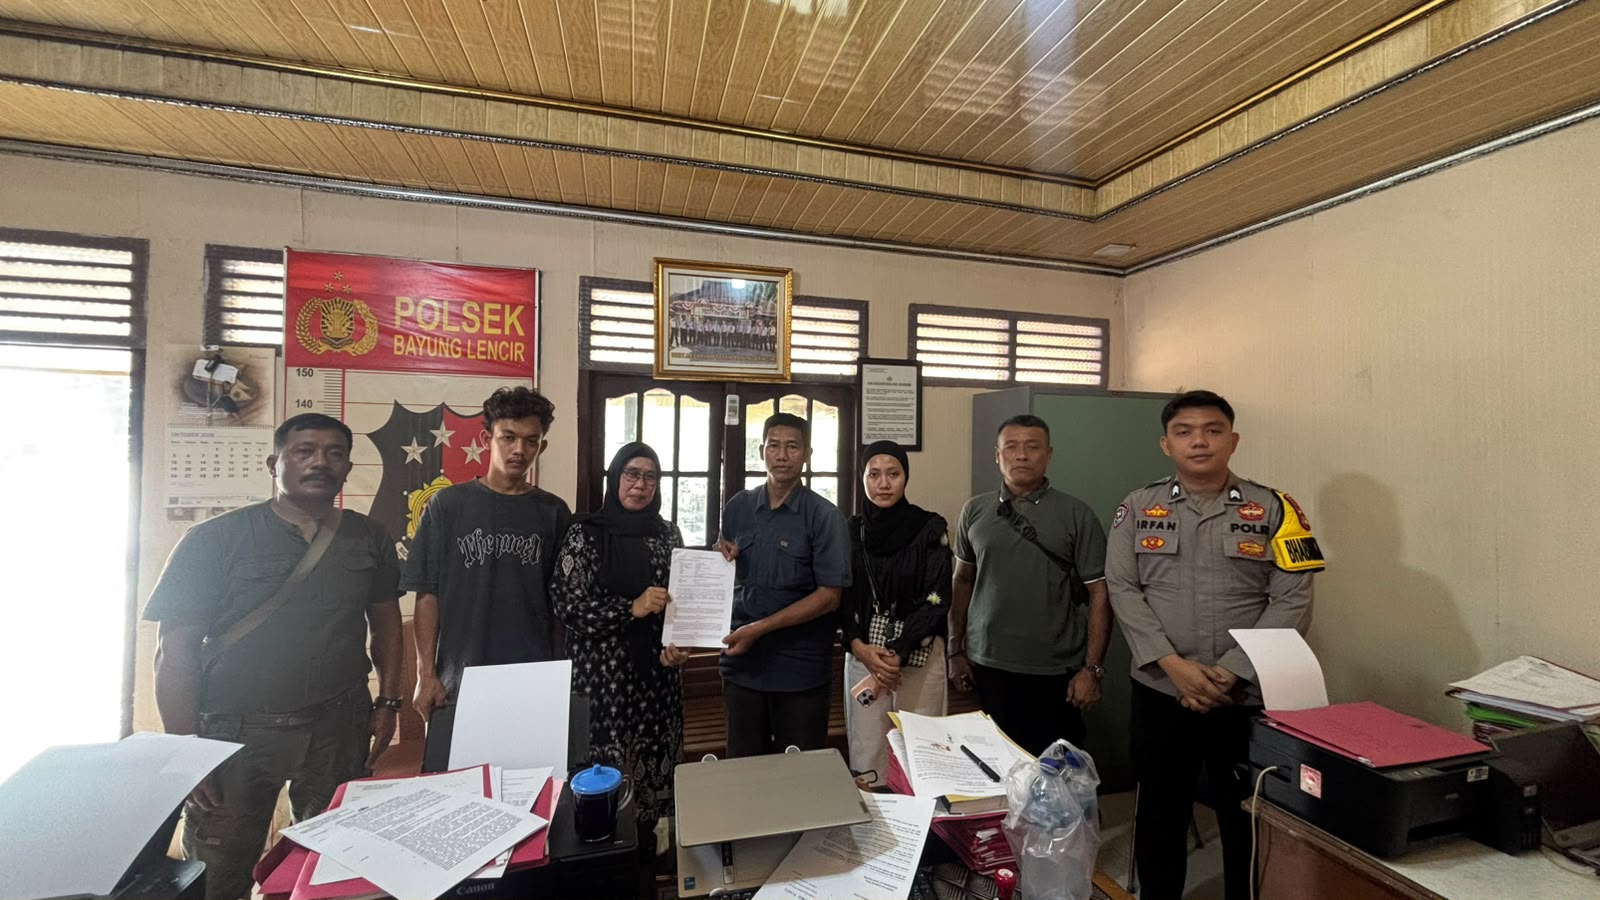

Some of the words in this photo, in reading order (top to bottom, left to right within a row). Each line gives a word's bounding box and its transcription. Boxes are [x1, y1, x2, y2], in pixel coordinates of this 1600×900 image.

[394, 296, 525, 337] POLSEK
[393, 335, 462, 359] BAYUNG
[467, 339, 525, 362] LENCIR
[296, 368, 314, 377] 150
[295, 398, 313, 408] 140
[1136, 520, 1176, 532] IRFAN
[1230, 523, 1270, 535] POLR
[456, 882, 495, 896] Canon
